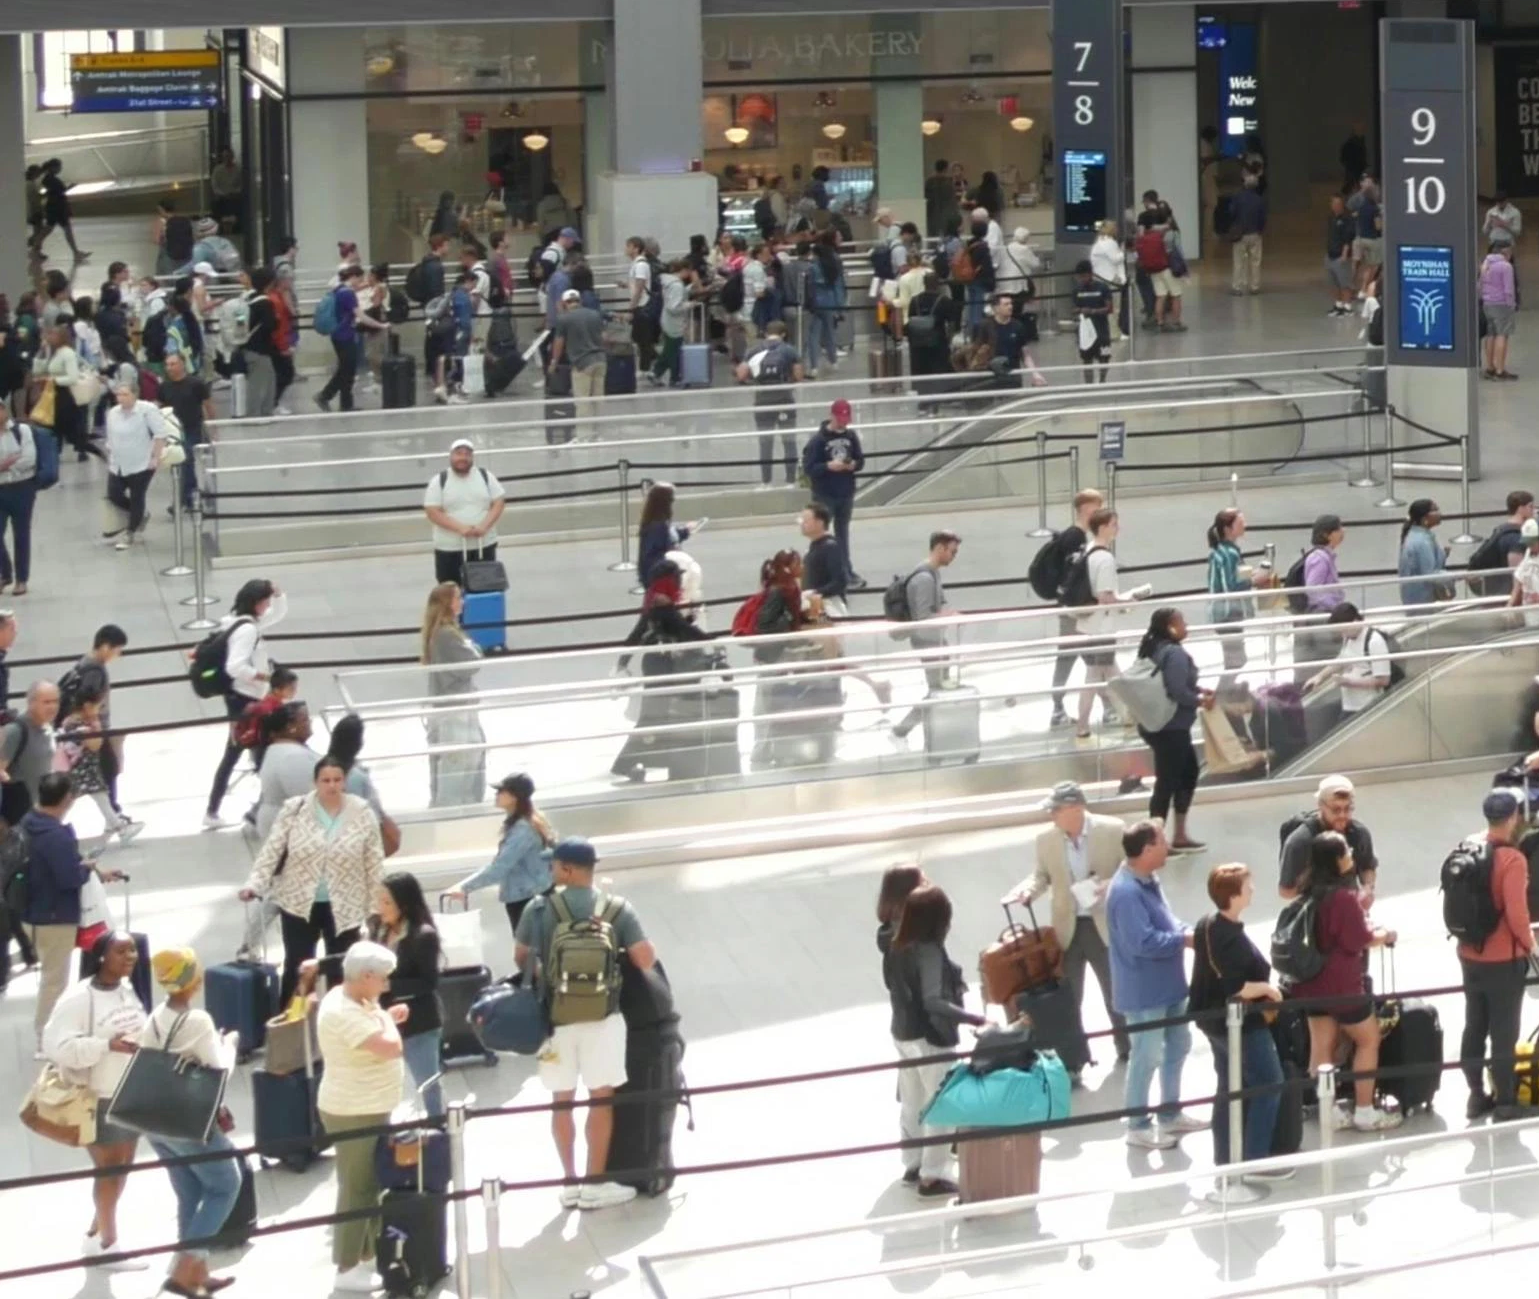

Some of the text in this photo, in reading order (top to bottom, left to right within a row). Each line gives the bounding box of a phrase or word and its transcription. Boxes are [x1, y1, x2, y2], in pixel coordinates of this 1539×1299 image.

[794, 30, 926, 63] BAKERY
[1073, 41, 1092, 72] 7
[1074, 94, 1094, 126] 8
[1228, 93, 1256, 107] New
[1411, 106, 1436, 146] 9
[1404, 175, 1446, 215] 10
